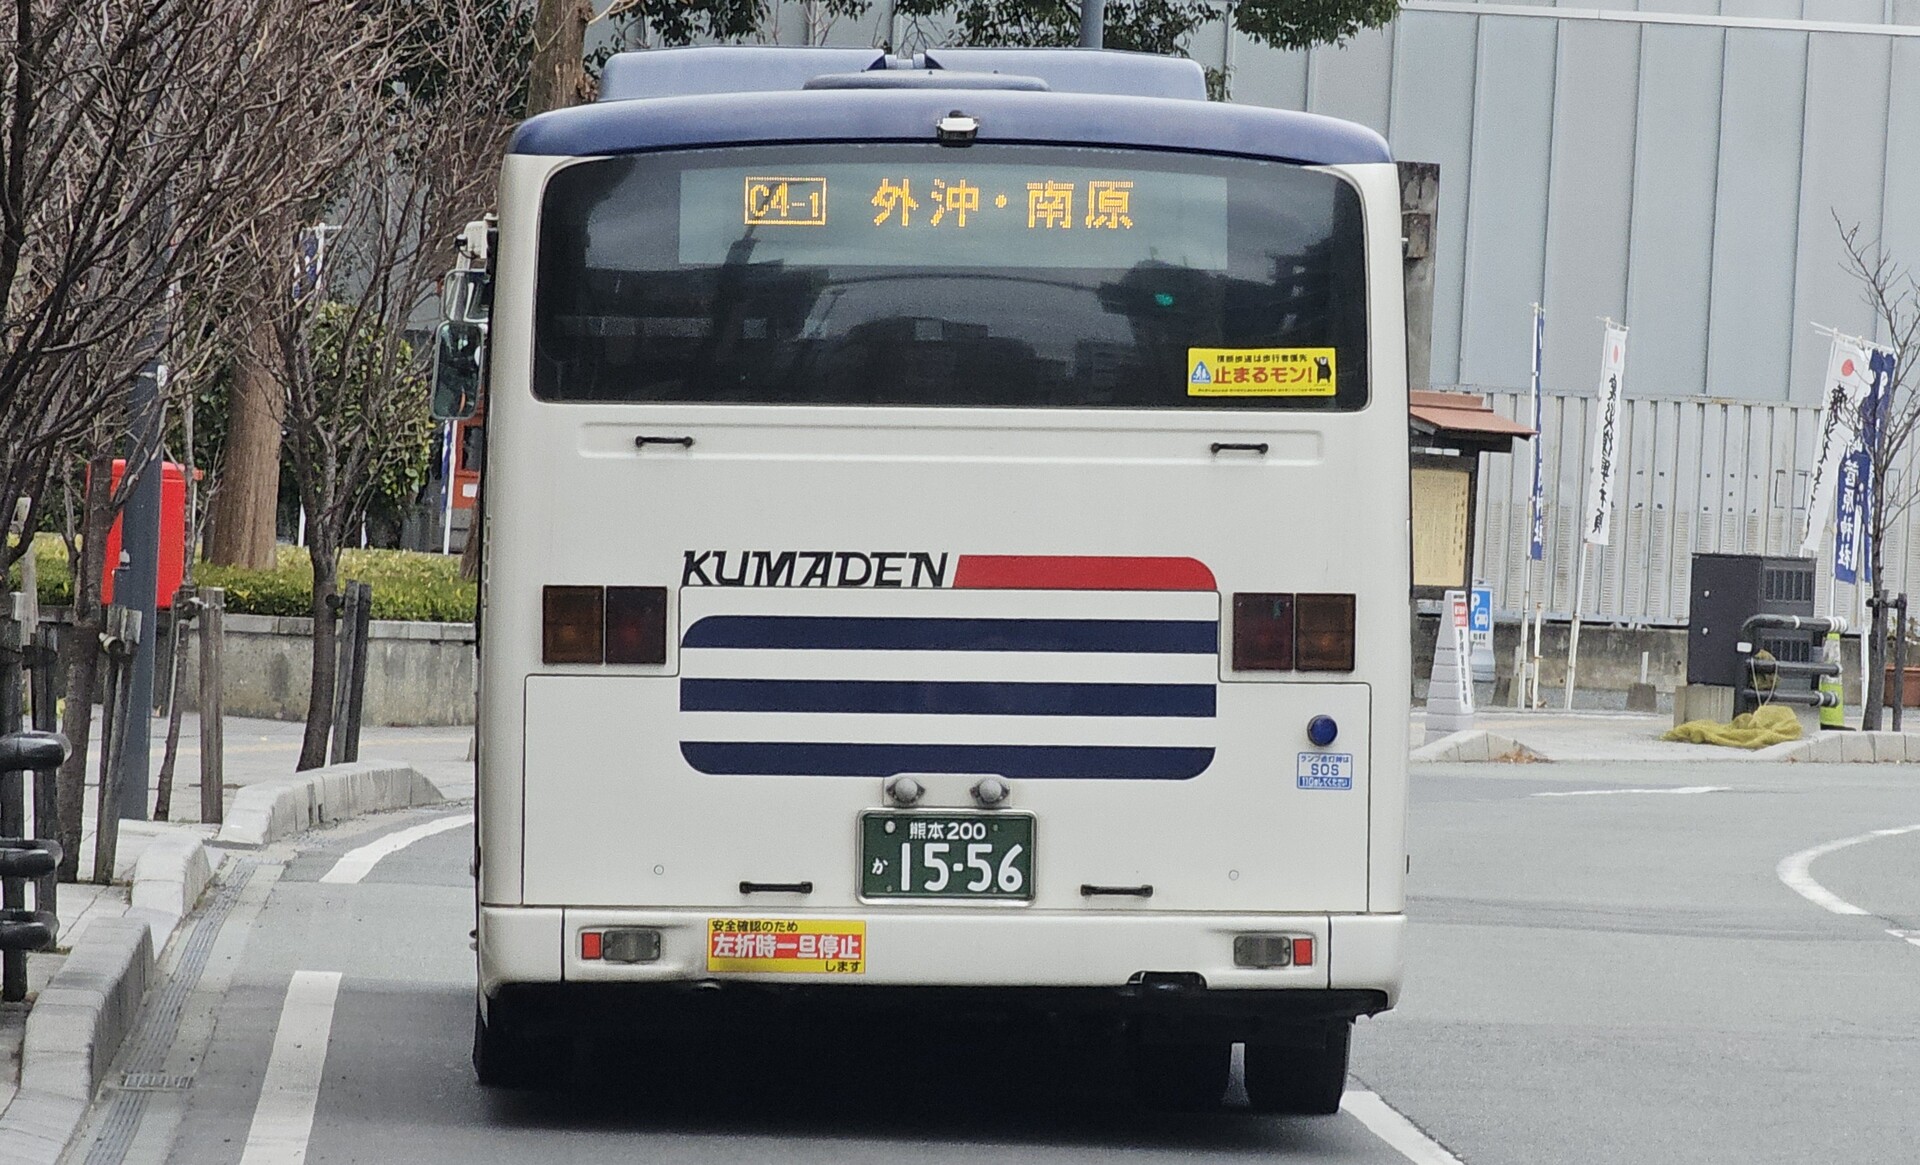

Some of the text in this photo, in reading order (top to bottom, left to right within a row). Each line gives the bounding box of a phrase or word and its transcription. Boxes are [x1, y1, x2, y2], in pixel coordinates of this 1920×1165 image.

[748, 178, 1134, 230] C4-1 外沖・南原
[681, 550, 949, 588] KUMADEN
[1311, 763, 1339, 776] SOS
[871, 842, 1023, 893] か 15-56
[712, 919, 798, 933] 安全確認のため
[713, 933, 860, 959] 左折時一旦停止
[825, 960, 861, 973] します
